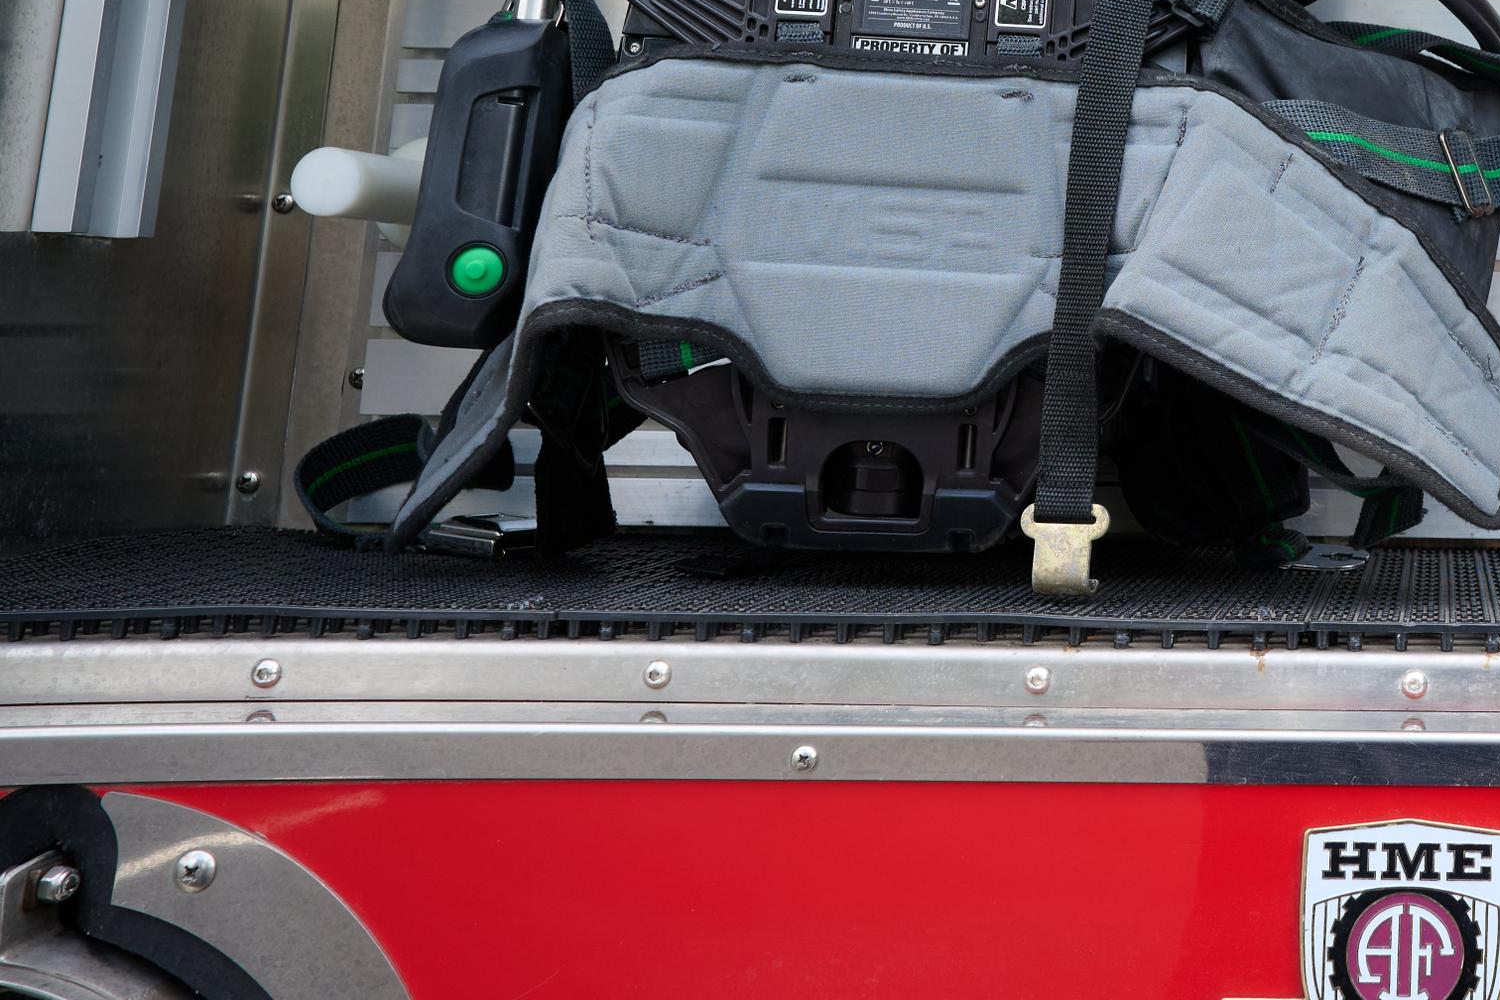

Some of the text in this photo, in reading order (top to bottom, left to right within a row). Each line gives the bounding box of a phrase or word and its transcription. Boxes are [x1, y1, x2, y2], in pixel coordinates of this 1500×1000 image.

[860, 40, 959, 56] PROPERTY OF
[1322, 841, 1493, 882] HME
